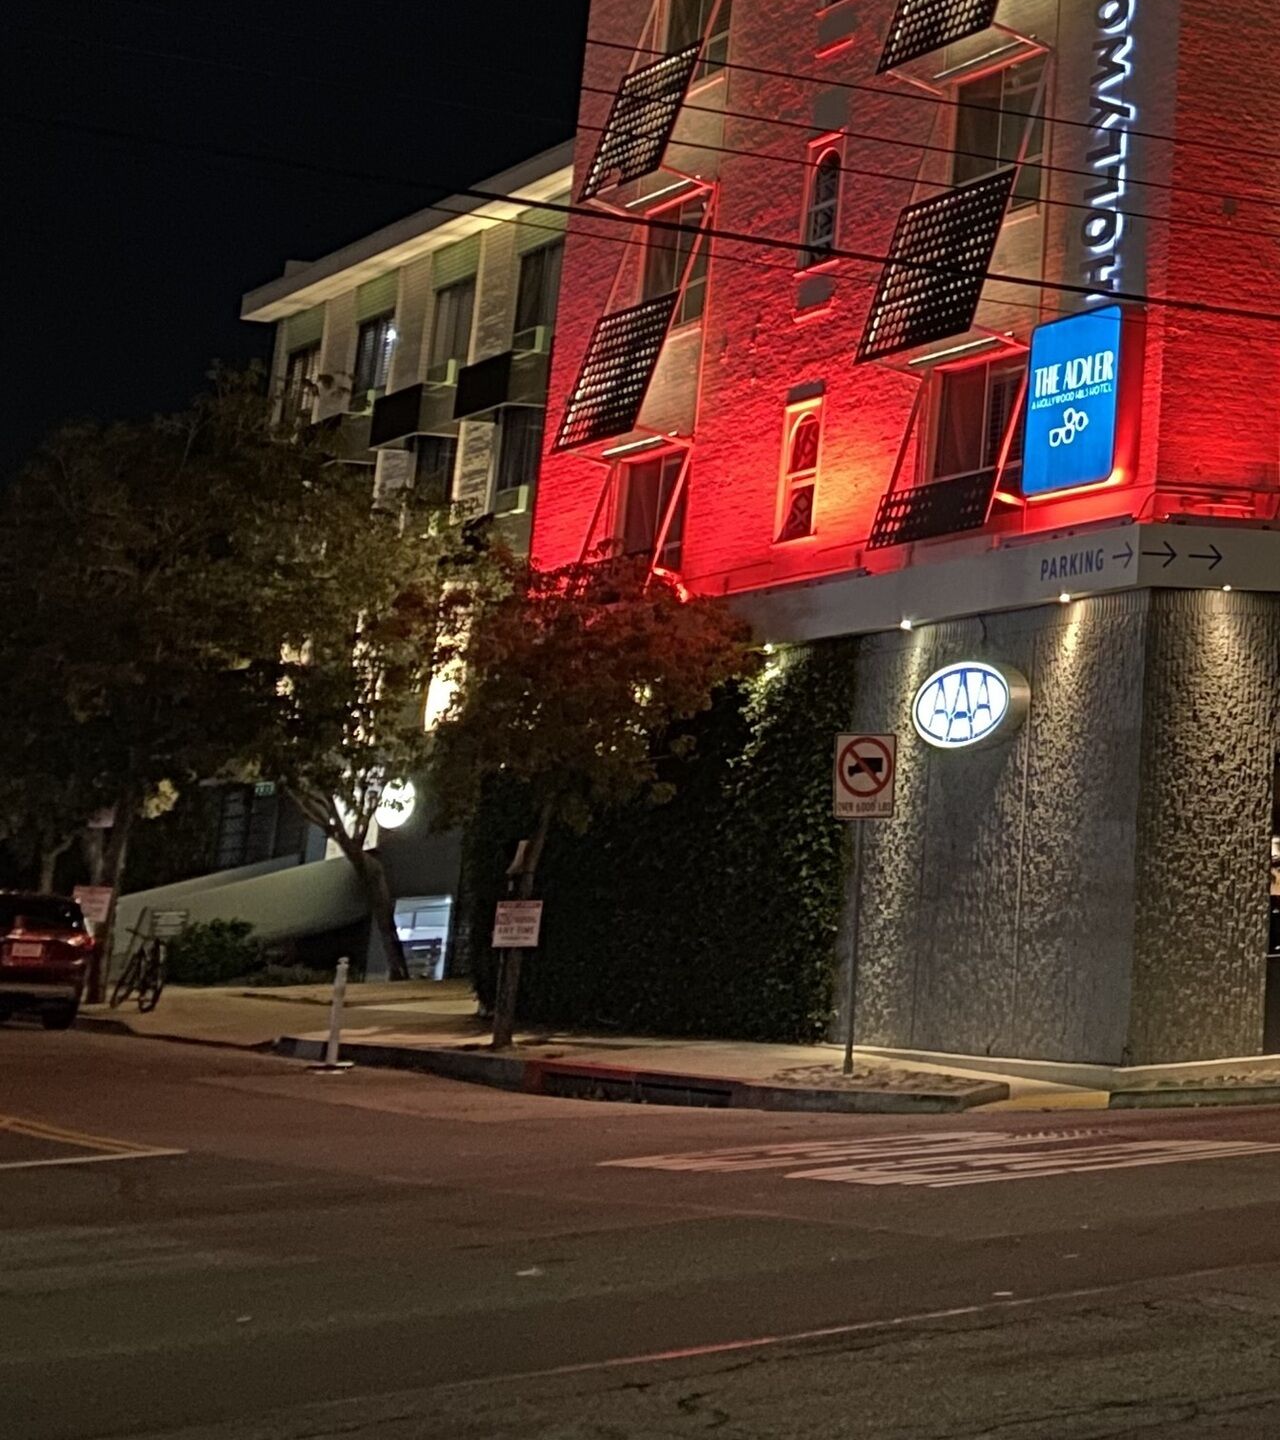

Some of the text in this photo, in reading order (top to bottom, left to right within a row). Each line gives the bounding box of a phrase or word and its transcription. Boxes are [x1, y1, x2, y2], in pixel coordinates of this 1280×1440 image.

[1034, 350, 1114, 398] THE ADLER
[1036, 392, 1074, 409] HOLLYWOOD
[1089, 382, 1112, 396] HOTEL
[1040, 548, 1104, 581] PARKING
[929, 668, 992, 741] AAA
